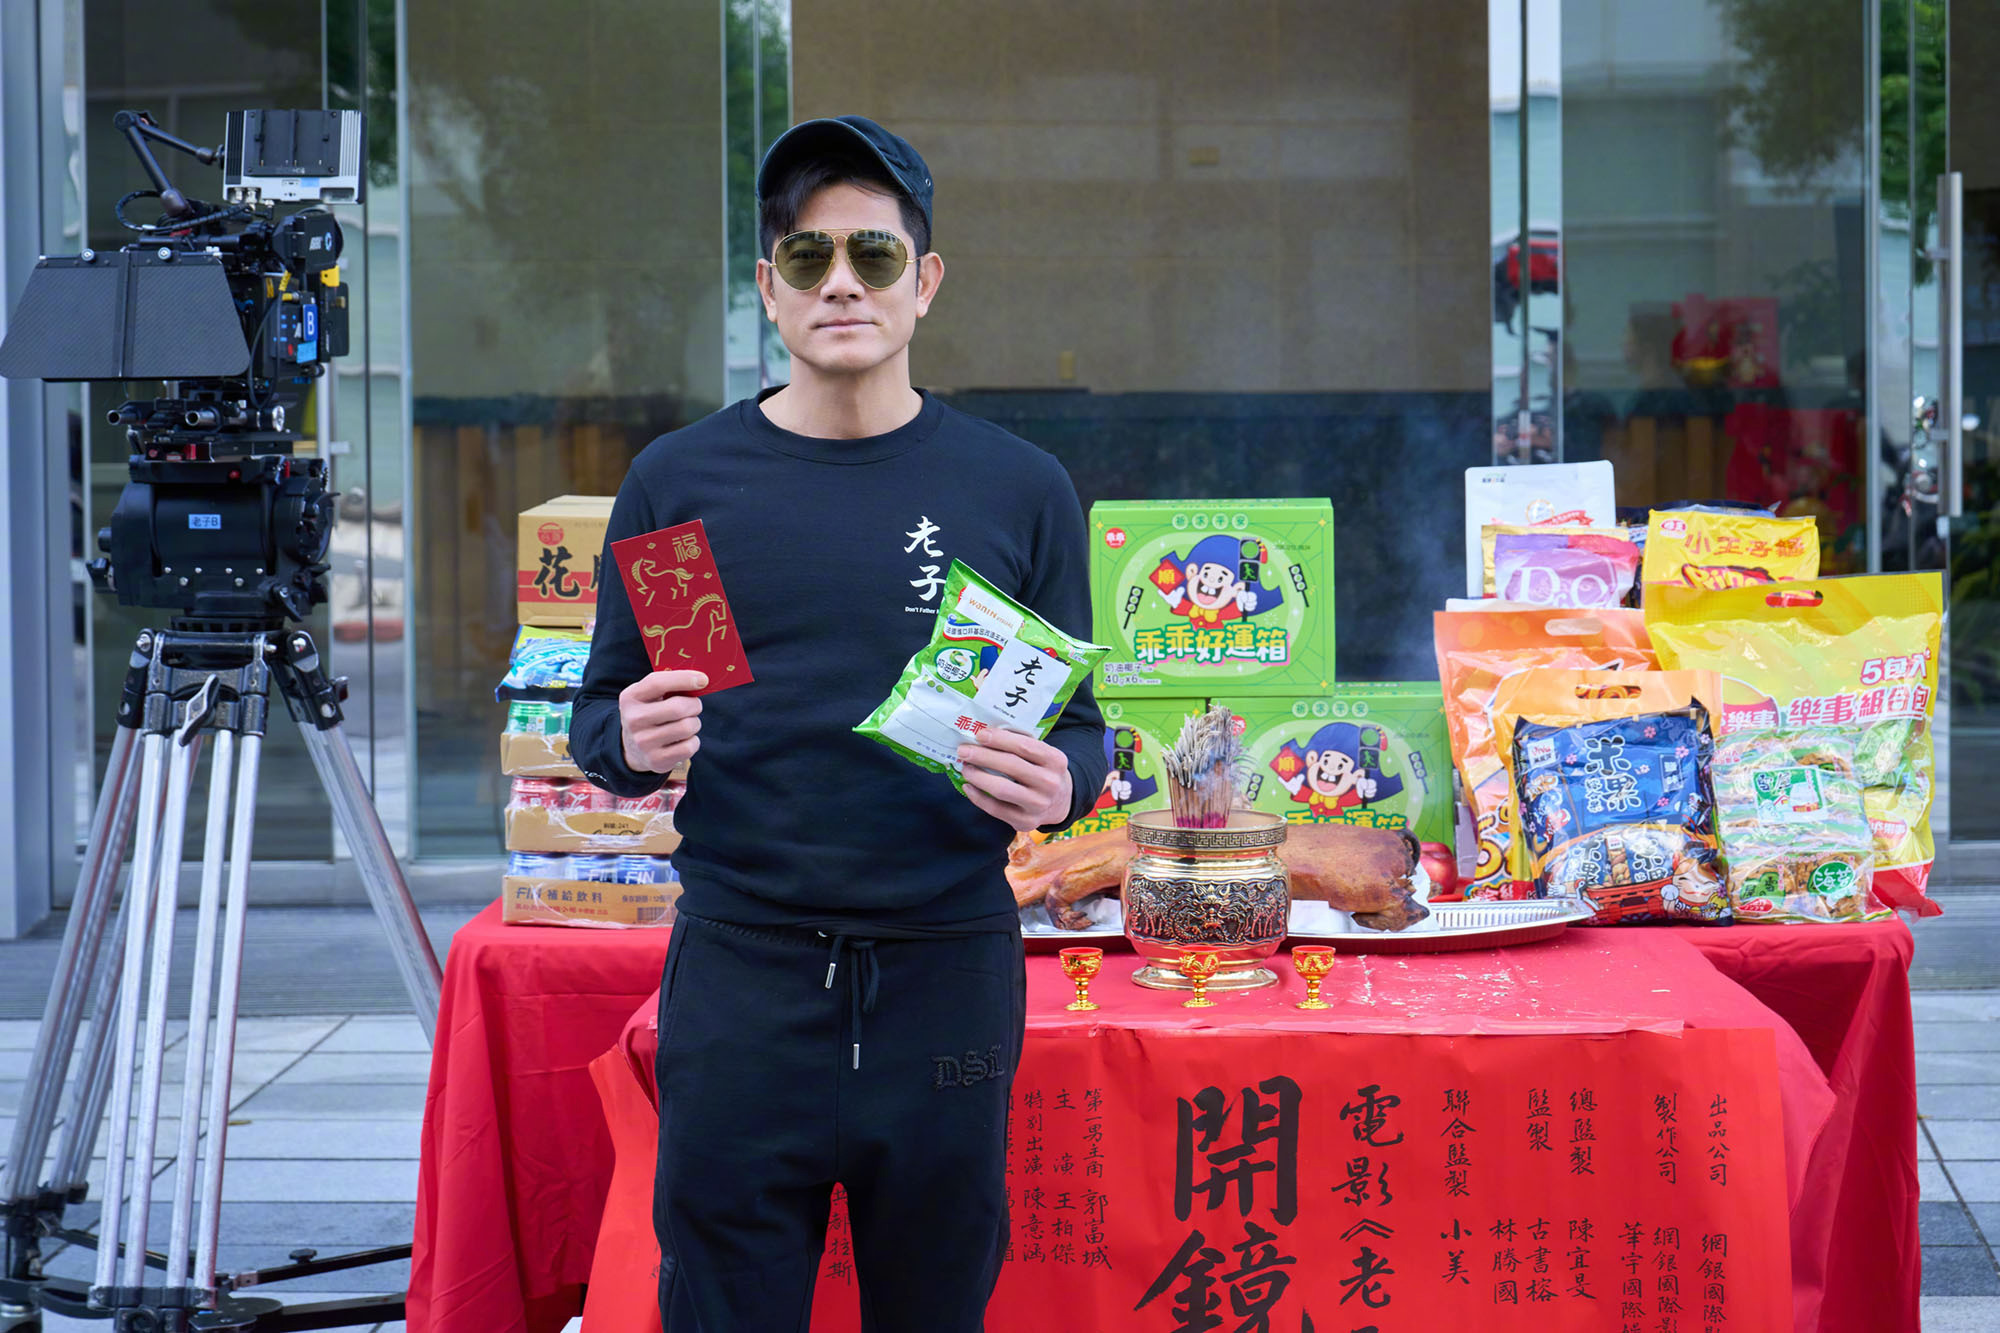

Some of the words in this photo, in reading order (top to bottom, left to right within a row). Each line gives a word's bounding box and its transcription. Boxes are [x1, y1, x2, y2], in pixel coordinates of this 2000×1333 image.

[534, 546, 601, 597] 花
[672, 533, 702, 562] 福
[903, 515, 946, 601] 老子
[1158, 569, 1175, 585] 順
[1004, 656, 1043, 708] 老子
[1136, 624, 1286, 662] 乖乖好運箱
[1789, 685, 1929, 726] 樂事組合包
[516, 887, 542, 900] FIN
[1023, 1089, 1044, 1176] 特別出演
[1082, 1088, 1105, 1179] 第一男主角
[1440, 1088, 1477, 1197] 聯合監製
[1526, 1088, 1553, 1151] 監製
[1568, 1088, 1598, 1176] 總監製
[1654, 1093, 1680, 1185] 製作公司
[1706, 1094, 1731, 1187] 出品公司
[1021, 1186, 1048, 1264] 陳意涵
[1051, 1192, 1077, 1265] 王柏傑
[1080, 1189, 1113, 1270] 郭富城
[1134, 1075, 1315, 1333] 開鏡
[1331, 1084, 1404, 1333] 電影《老
[1440, 1218, 1473, 1285] 小美
[1489, 1218, 1523, 1304] 林勝國
[1525, 1217, 1558, 1302] 古書榕
